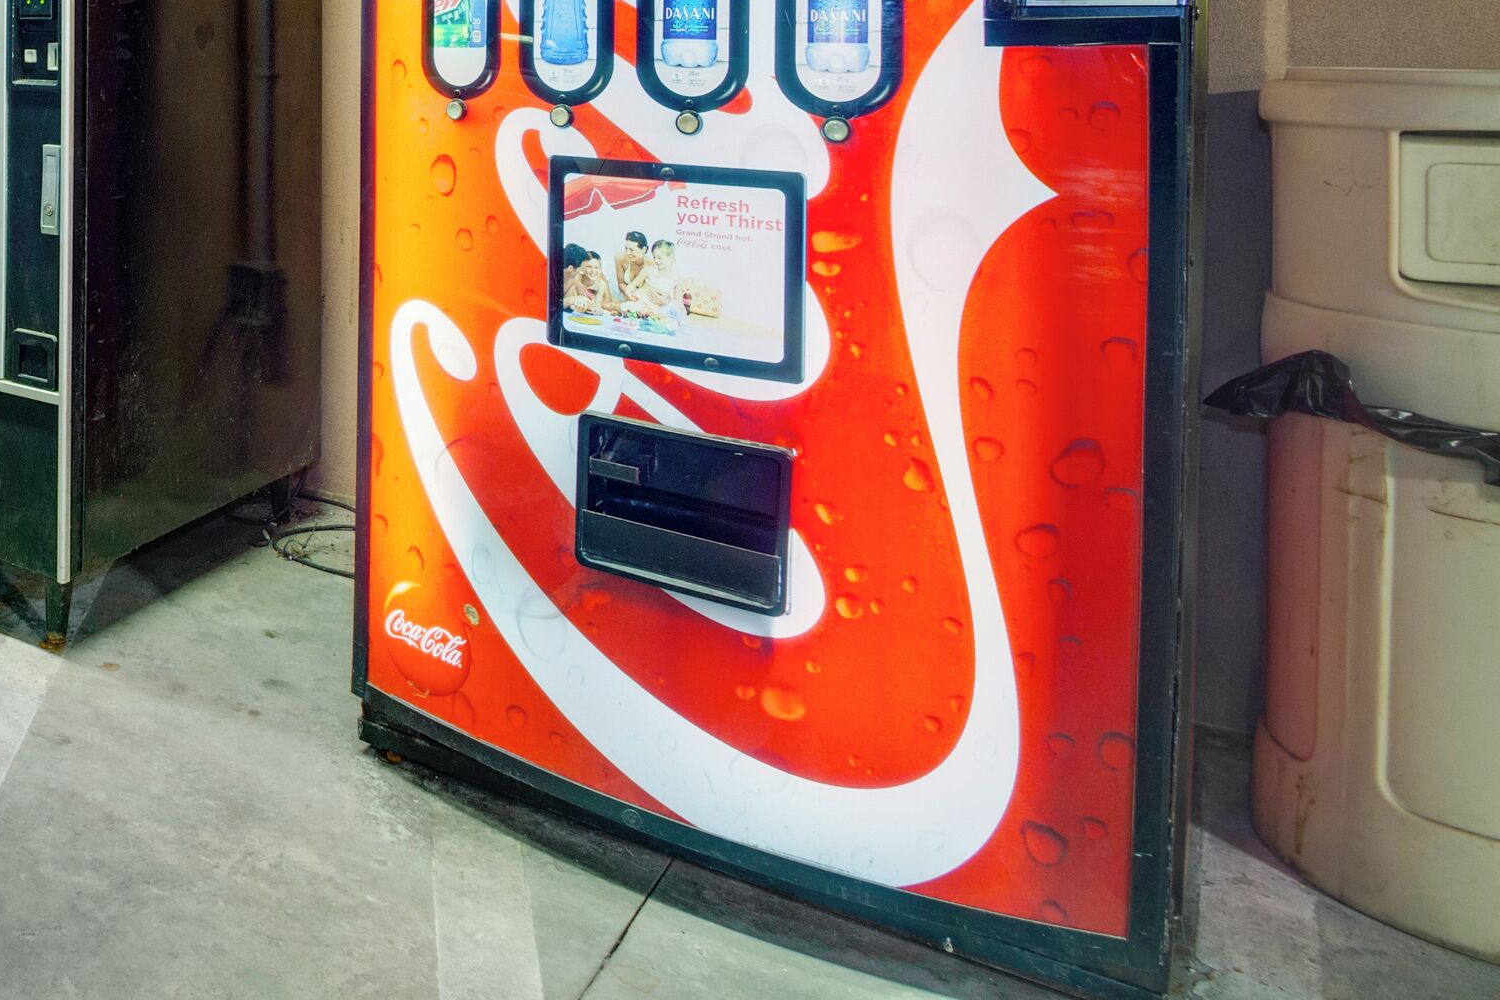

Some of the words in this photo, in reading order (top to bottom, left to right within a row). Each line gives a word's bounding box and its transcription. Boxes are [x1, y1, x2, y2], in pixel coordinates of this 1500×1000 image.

[665, 4, 714, 20] DASANI
[810, 6, 865, 22] DASANI
[677, 195, 750, 213] Refresh
[677, 212, 718, 225] your
[726, 214, 782, 231] Thirst
[676, 229, 701, 237] Grand
[704, 232, 732, 240] Strand
[385, 609, 466, 668] Coca-Cola
